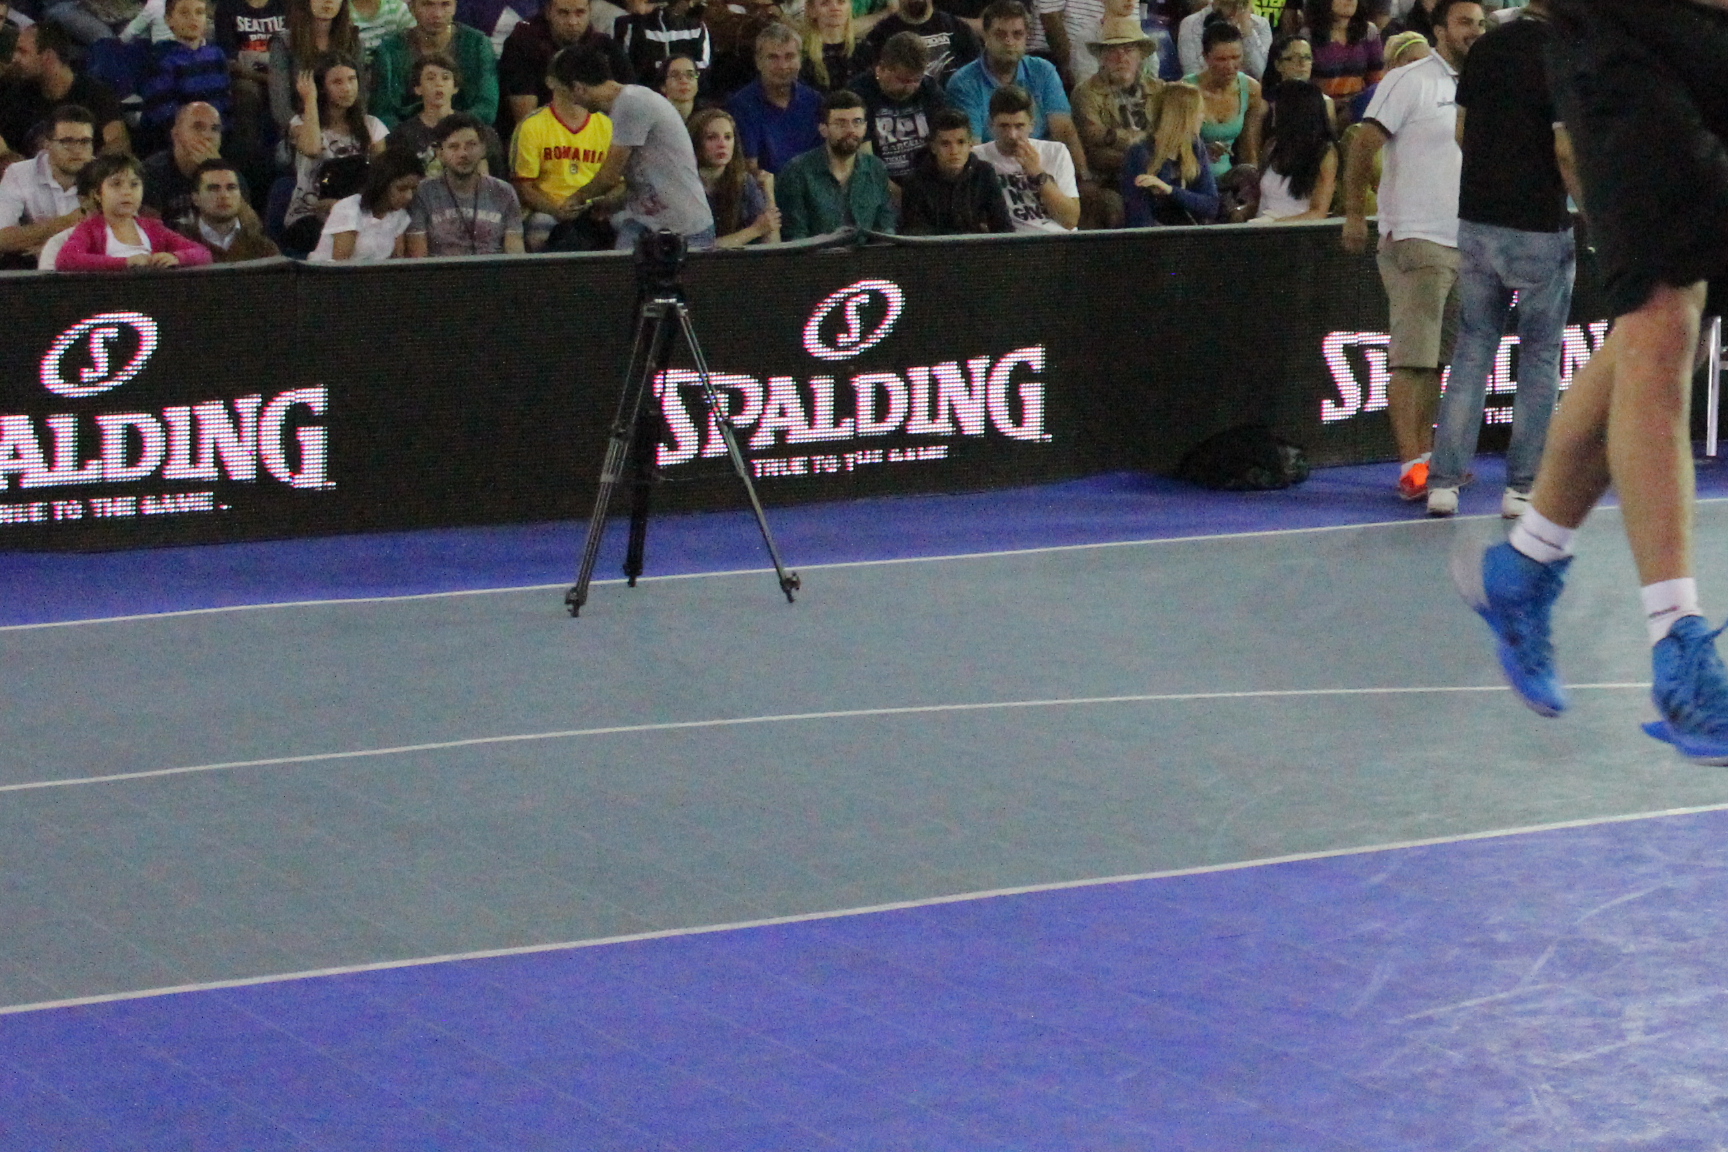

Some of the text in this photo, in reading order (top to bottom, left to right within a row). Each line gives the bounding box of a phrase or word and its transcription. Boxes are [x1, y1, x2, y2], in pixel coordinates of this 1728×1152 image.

[236, 16, 287, 32] SEATTLE
[654, 344, 1051, 467] SPALDING
[810, 454, 842, 474] TO
[50, 500, 86, 521] TO
[89, 496, 137, 518] THE
